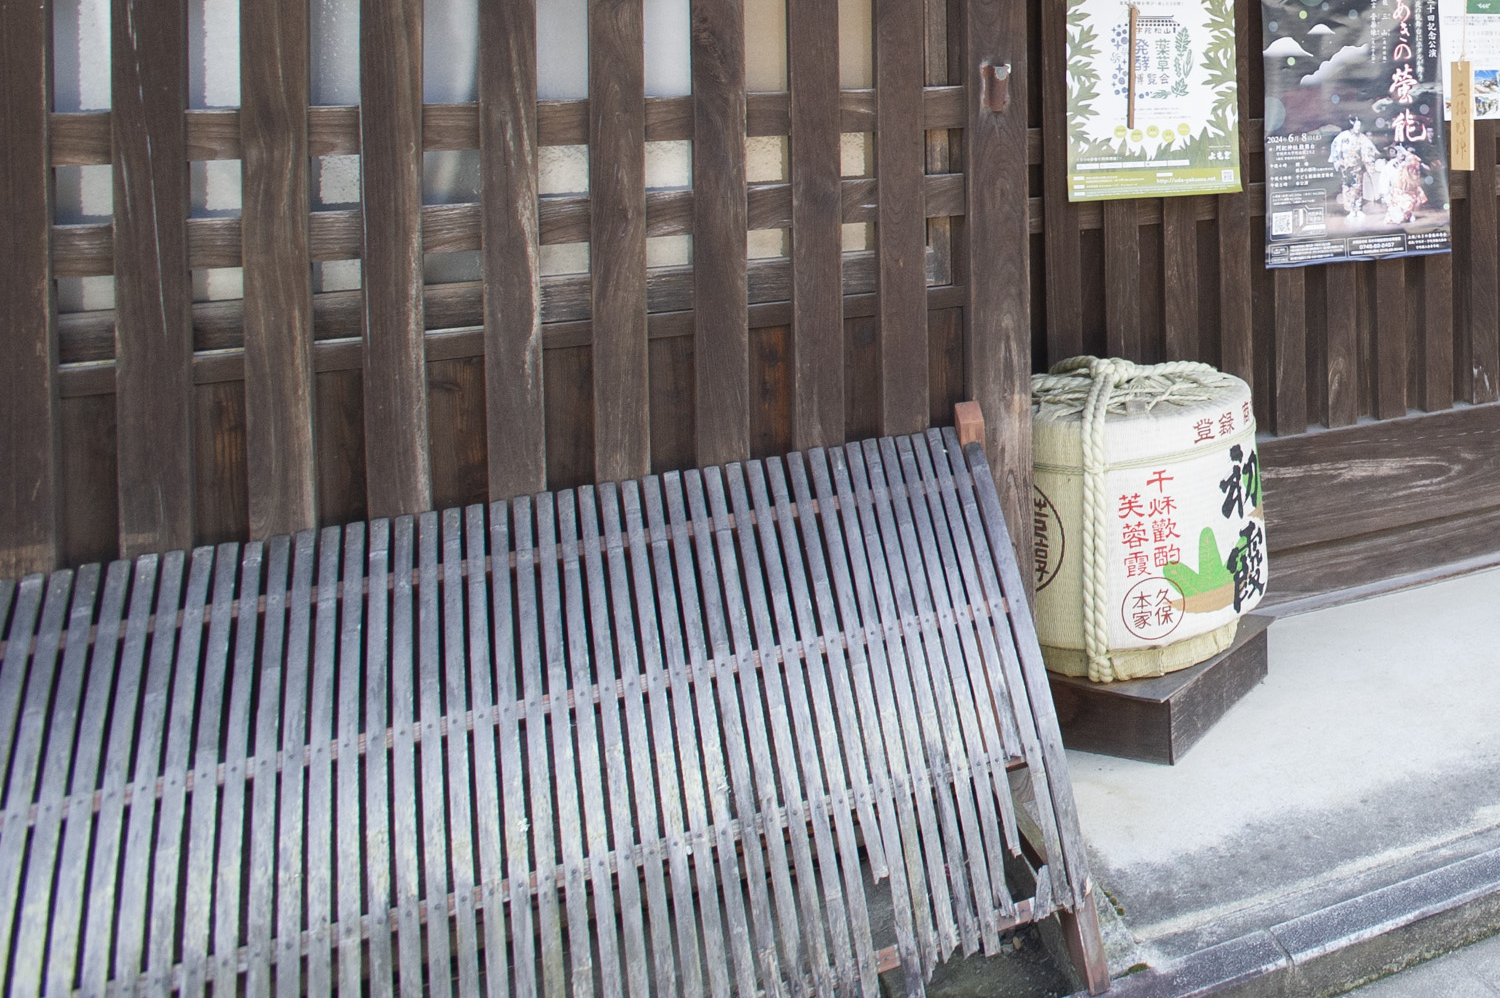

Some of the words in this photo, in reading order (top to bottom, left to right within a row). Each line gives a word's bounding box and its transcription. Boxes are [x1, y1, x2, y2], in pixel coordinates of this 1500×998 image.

[1155, 38, 1171, 72] 薬草
[1193, 399, 1253, 444] 登録商
[1118, 492, 1152, 579] 芙蓉霞
[1219, 443, 1267, 614] 初霞
[1132, 590, 1152, 630] 本家
[1154, 589, 1174, 627] 久保
